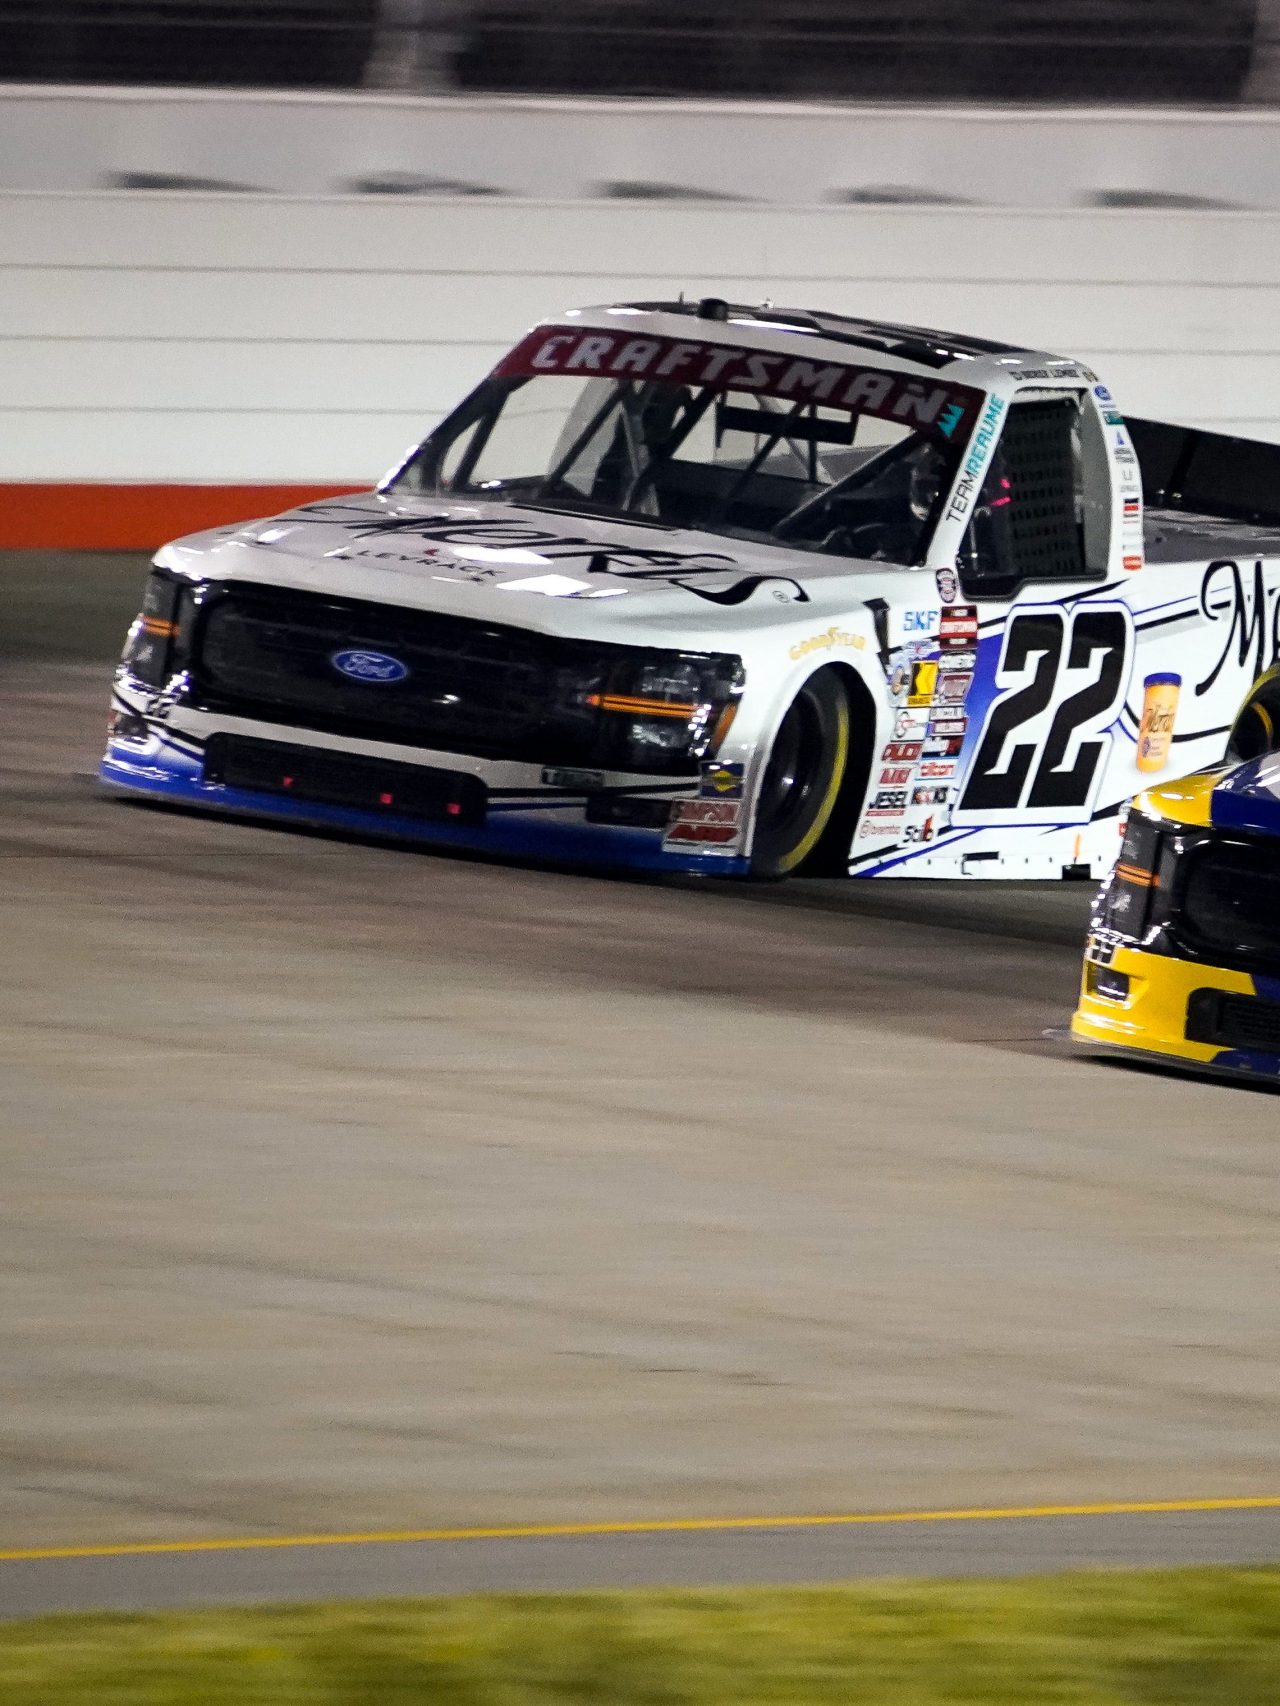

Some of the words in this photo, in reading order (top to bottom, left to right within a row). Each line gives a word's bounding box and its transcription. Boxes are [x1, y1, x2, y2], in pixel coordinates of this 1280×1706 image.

[529, 335, 949, 425] CRAFTSMAN
[356, 549, 506, 577] LEVRACK
[903, 610, 939, 632] SKF
[342, 652, 397, 678] Ford
[958, 611, 1127, 810] 22
